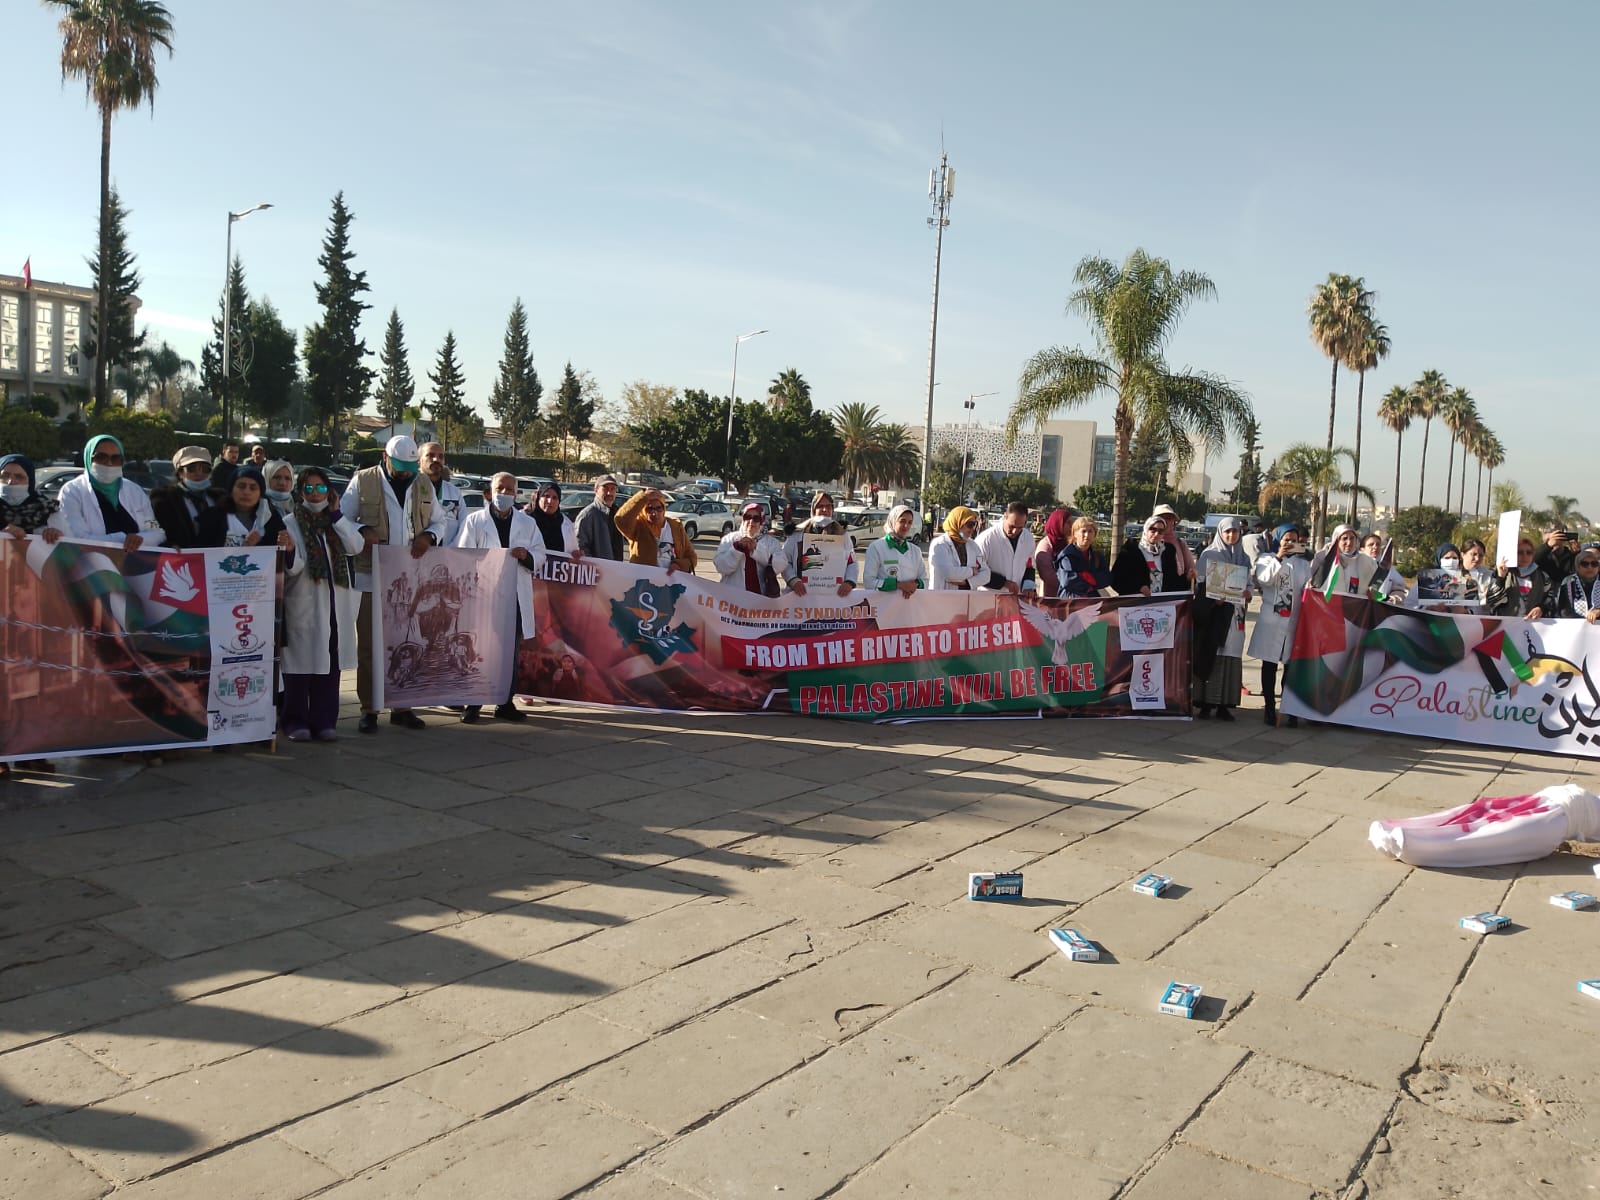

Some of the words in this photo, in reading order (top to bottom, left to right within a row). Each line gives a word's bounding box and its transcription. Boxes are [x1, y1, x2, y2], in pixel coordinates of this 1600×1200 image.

[534, 560, 600, 586] ALESTINE
[697, 594, 714, 608] LA
[718, 600, 790, 619] CHAMBRE
[793, 606, 878, 619] SYNDICALE
[745, 643, 808, 668] FROM
[813, 639, 856, 665] THE
[861, 633, 924, 661] RIVER
[927, 629, 951, 655] TO
[956, 625, 989, 651] THE
[992, 620, 1023, 647] SEA
[800, 678, 945, 714] PALASTINE
[949, 672, 1005, 706] WILL
[1009, 667, 1037, 699] BE
[1041, 662, 1097, 694] FREE
[1369, 675, 1539, 724] Palastine
